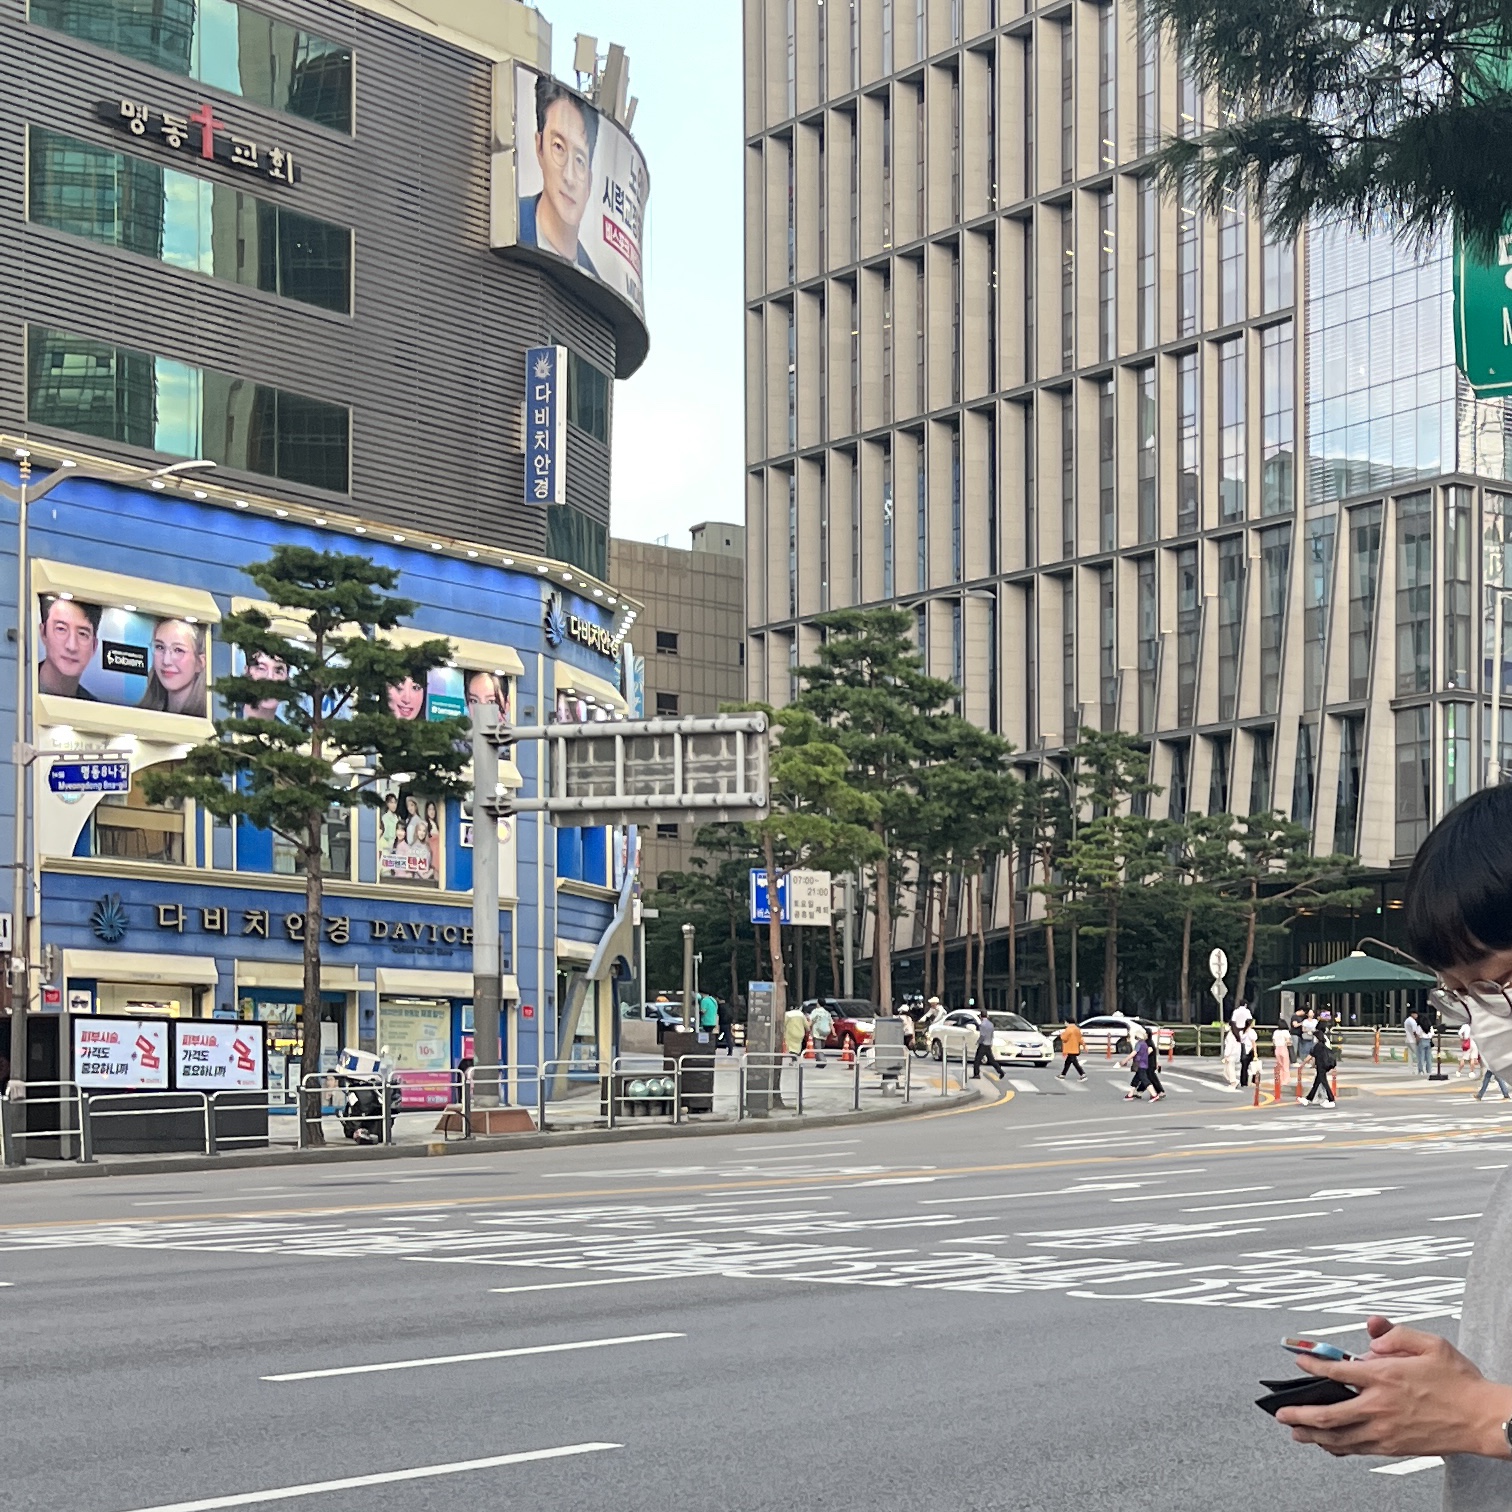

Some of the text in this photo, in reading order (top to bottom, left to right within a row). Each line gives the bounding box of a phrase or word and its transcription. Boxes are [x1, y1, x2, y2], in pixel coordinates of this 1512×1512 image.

[533, 382, 553, 500] 다비치안경
[807, 887, 829, 897] 21:00
[157, 903, 351, 945] 다비치안경
[80, 1046, 111, 1060] 가격도
[181, 1049, 210, 1062] 가격도
[81, 1062, 129, 1075] 중요하니까
[182, 1065, 227, 1078] 중요하니까
